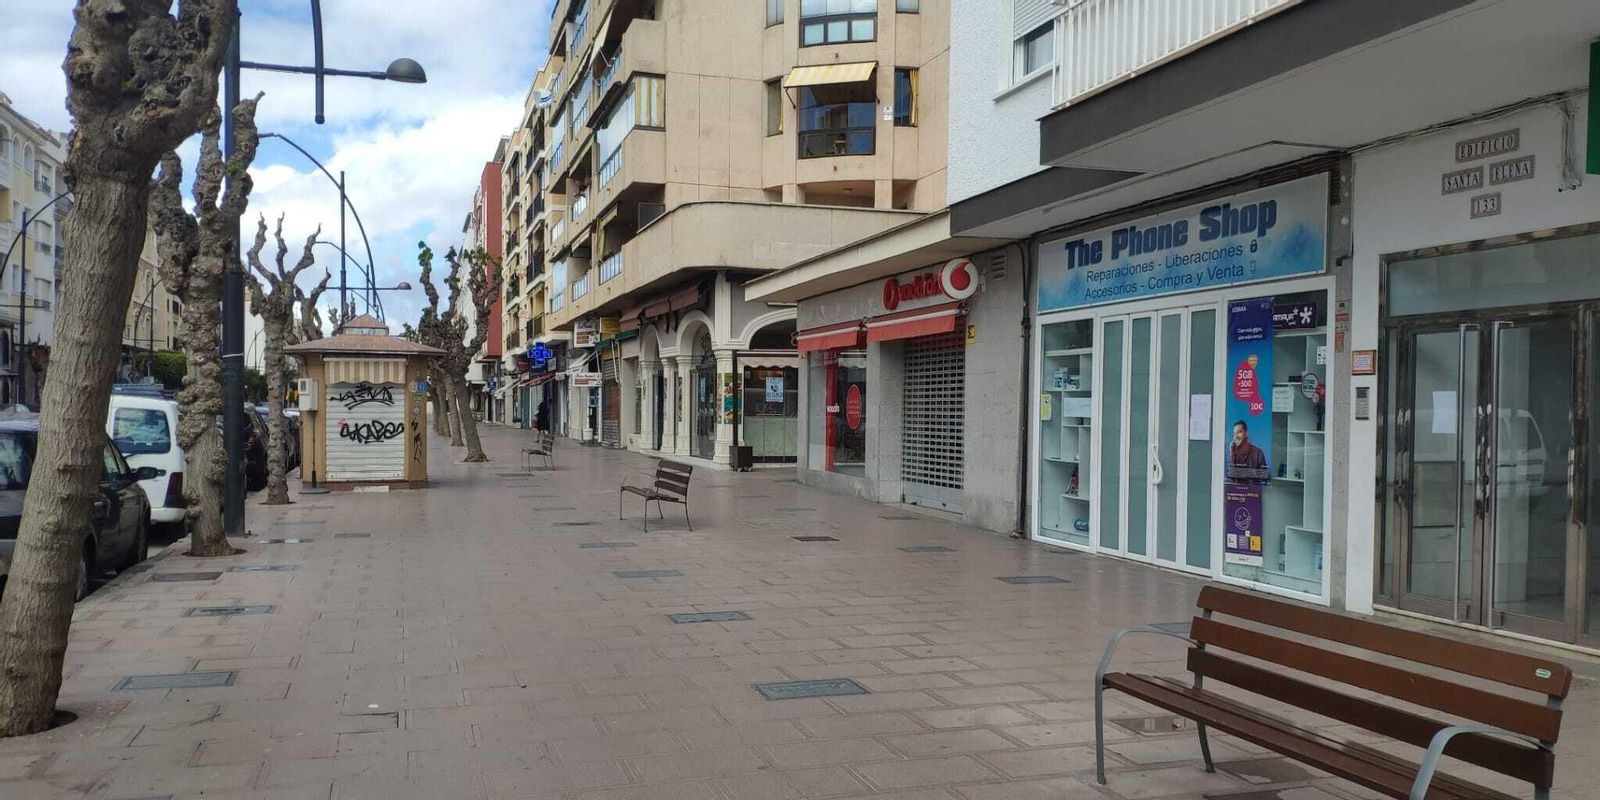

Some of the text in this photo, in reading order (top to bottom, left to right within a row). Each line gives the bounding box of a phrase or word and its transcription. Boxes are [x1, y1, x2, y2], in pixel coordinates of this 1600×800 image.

[1460, 137, 1514, 158] EDIFICIO
[1446, 161, 1530, 190] SANTA ELENA
[1475, 198, 1496, 213] 133
[1064, 199, 1277, 270] The Phone Shop
[1085, 260, 1155, 284] Reparaciones
[1164, 244, 1243, 269] Liberaciones
[1084, 281, 1138, 301] Accesorios
[1147, 273, 1193, 294] Compra
[1196, 273, 1205, 285] y
[1207, 264, 1244, 281] Venta
[1237, 369, 1253, 380] 5GB
[1250, 402, 1263, 411] 10€
